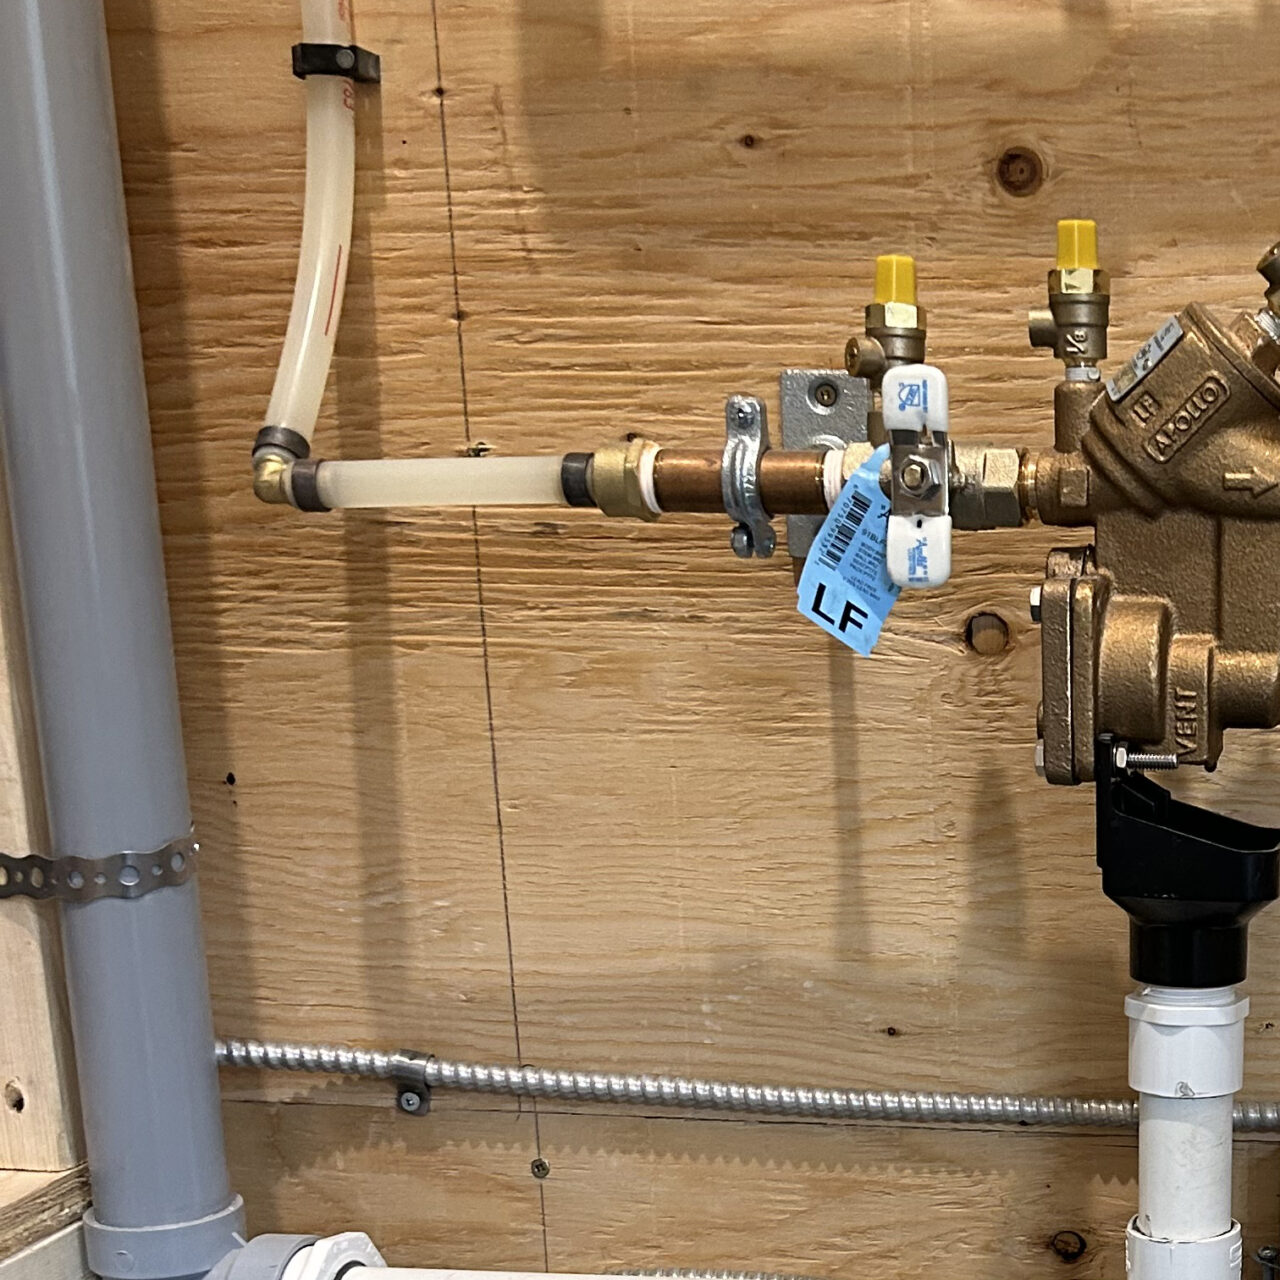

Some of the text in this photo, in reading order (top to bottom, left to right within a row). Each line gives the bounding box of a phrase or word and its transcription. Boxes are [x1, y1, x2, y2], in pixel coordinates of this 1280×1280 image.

[1154, 382, 1219, 455] APOLLO
[811, 582, 869, 633] LF
[1175, 686, 1198, 757] VENT
